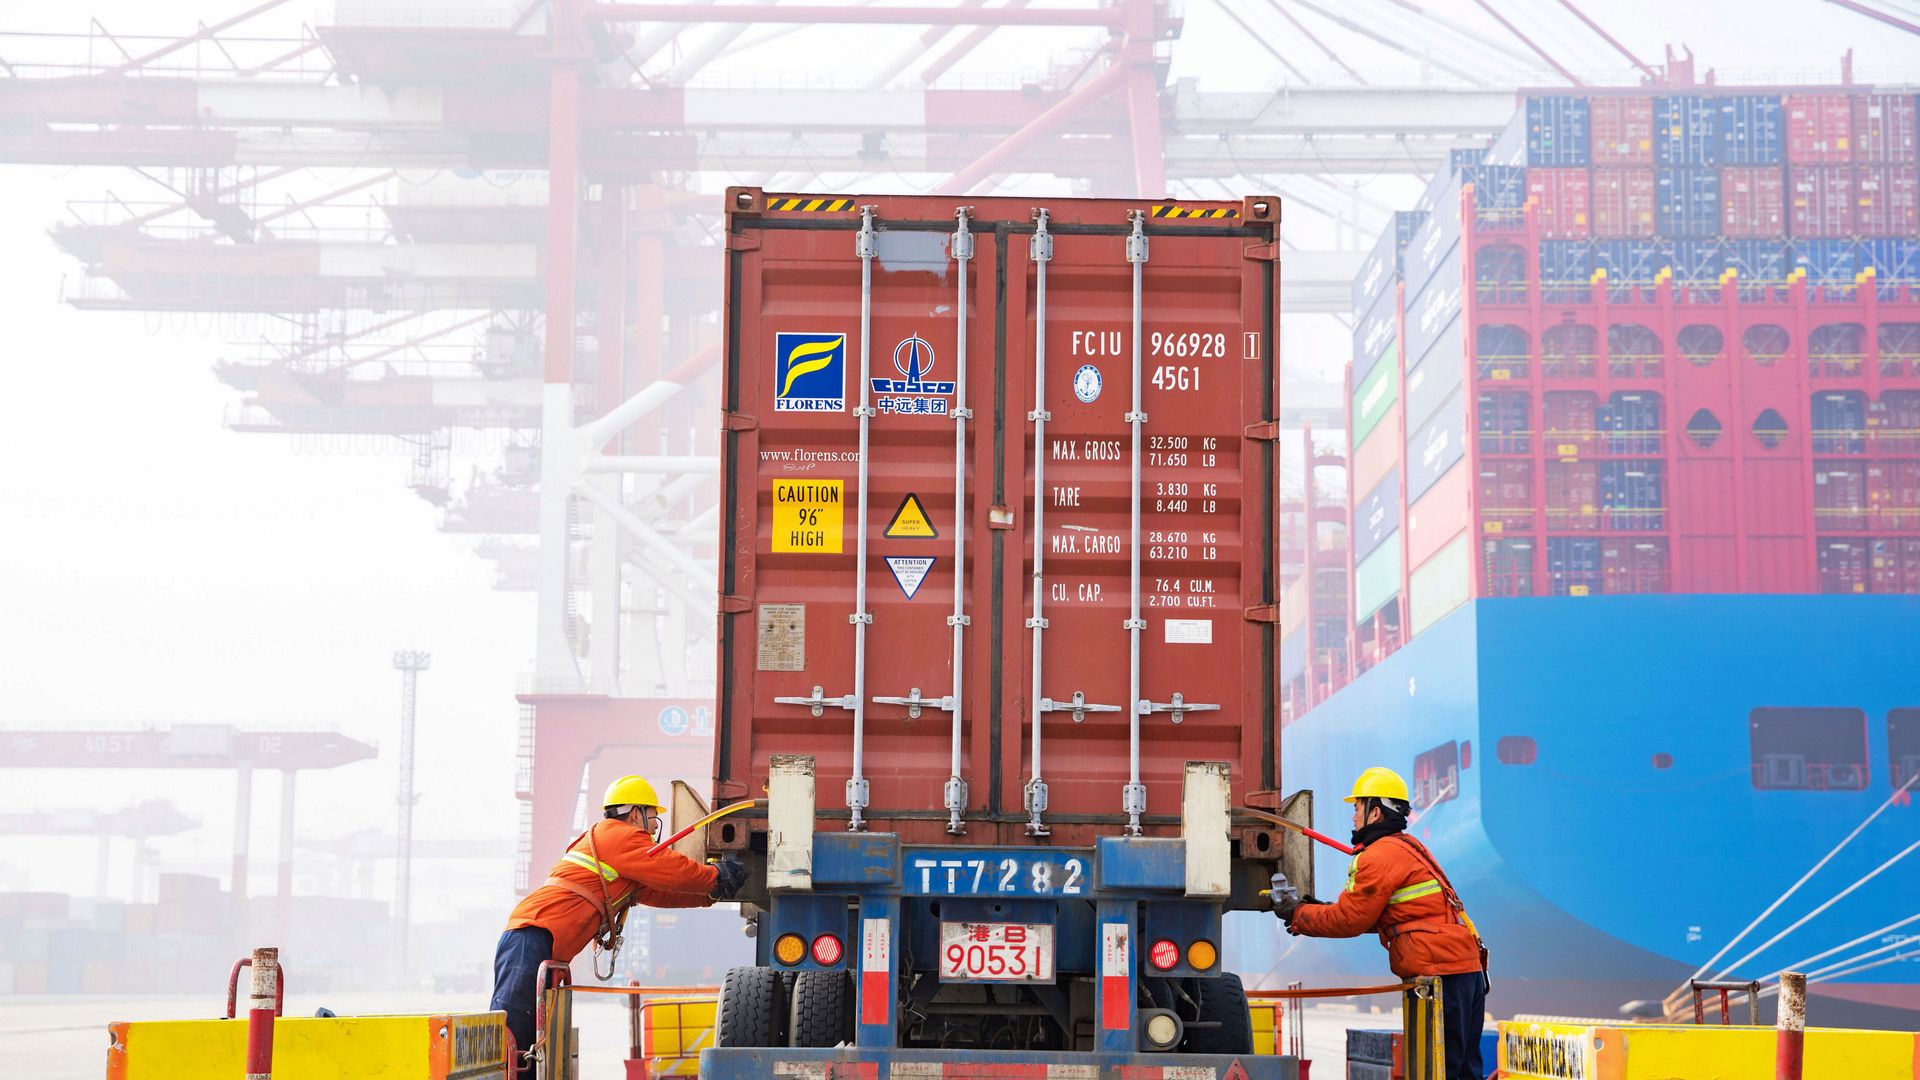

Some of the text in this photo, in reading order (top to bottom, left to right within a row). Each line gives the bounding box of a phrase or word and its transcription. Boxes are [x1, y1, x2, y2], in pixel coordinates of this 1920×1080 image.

[1072, 331, 1121, 356] FCIU
[1151, 332, 1226, 358] 966928
[871, 378, 956, 394] COSCO
[1151, 366, 1200, 391] 45G1
[776, 399, 843, 411] FLORENS
[878, 397, 947, 415] 中远集团
[1053, 440, 1121, 461] MAX. GROSS
[1203, 437, 1217, 451] KG
[1202, 454, 1216, 468] LB
[777, 485, 839, 503] CAUTION
[1053, 486, 1081, 507] TARE
[1203, 483, 1217, 497] KG
[1203, 500, 1216, 513] LB
[790, 531, 825, 547] HIGH
[1052, 534, 1121, 554] MAX. CARGO
[1202, 532, 1217, 544] KG
[1203, 547, 1217, 560] LB
[1052, 583, 1104, 602] CU. CAP.
[1155, 578, 1181, 592] 76.4
[946, 944, 1041, 976] 90531
